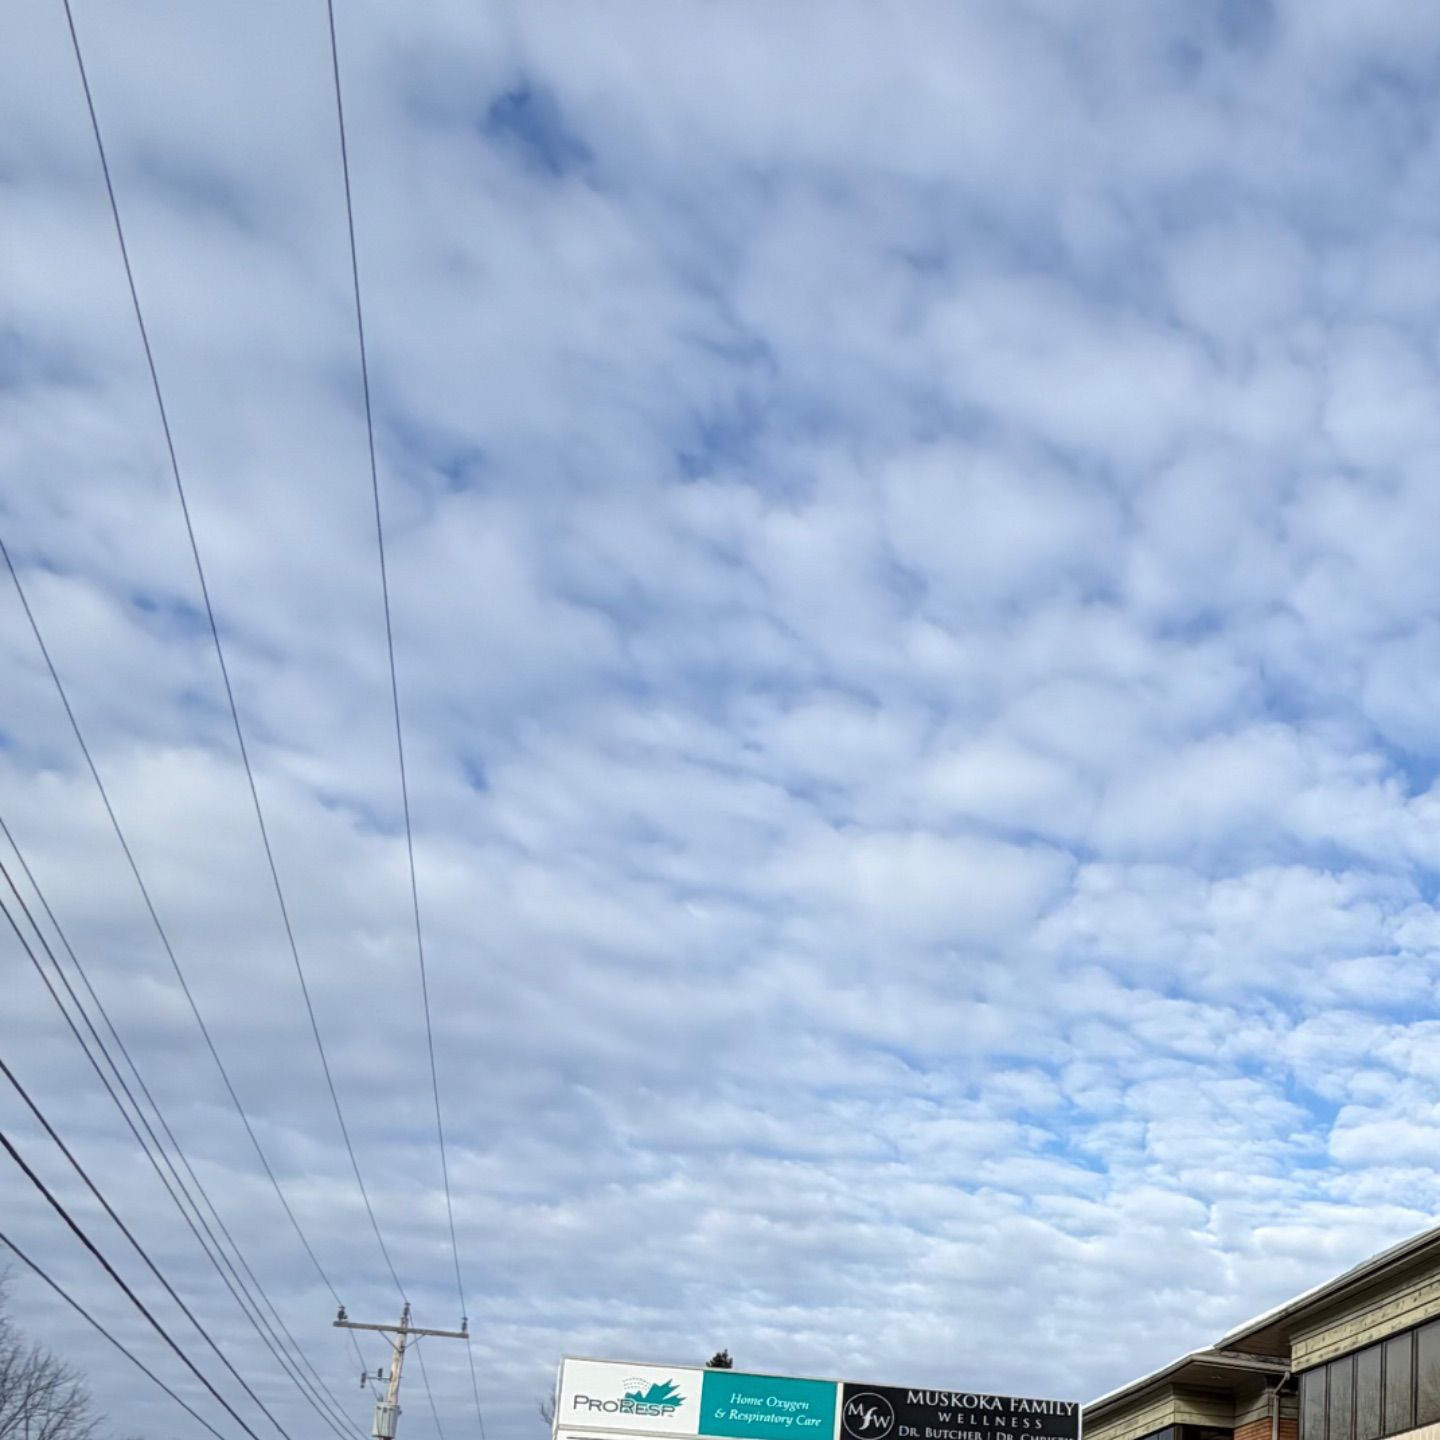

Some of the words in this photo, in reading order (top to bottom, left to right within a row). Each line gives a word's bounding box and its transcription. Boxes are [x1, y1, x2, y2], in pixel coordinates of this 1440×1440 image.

[730, 1393, 763, 1407] Home
[766, 1396, 809, 1412] Oxygen
[906, 1390, 1003, 1411] MUSKOKA
[1010, 1397, 1075, 1416] FAMILY
[714, 1408, 726, 1419] &
[728, 1409, 793, 1427] Respiratory
[796, 1415, 821, 1427] Care
[938, 1411, 1042, 1429] WELLNESS
